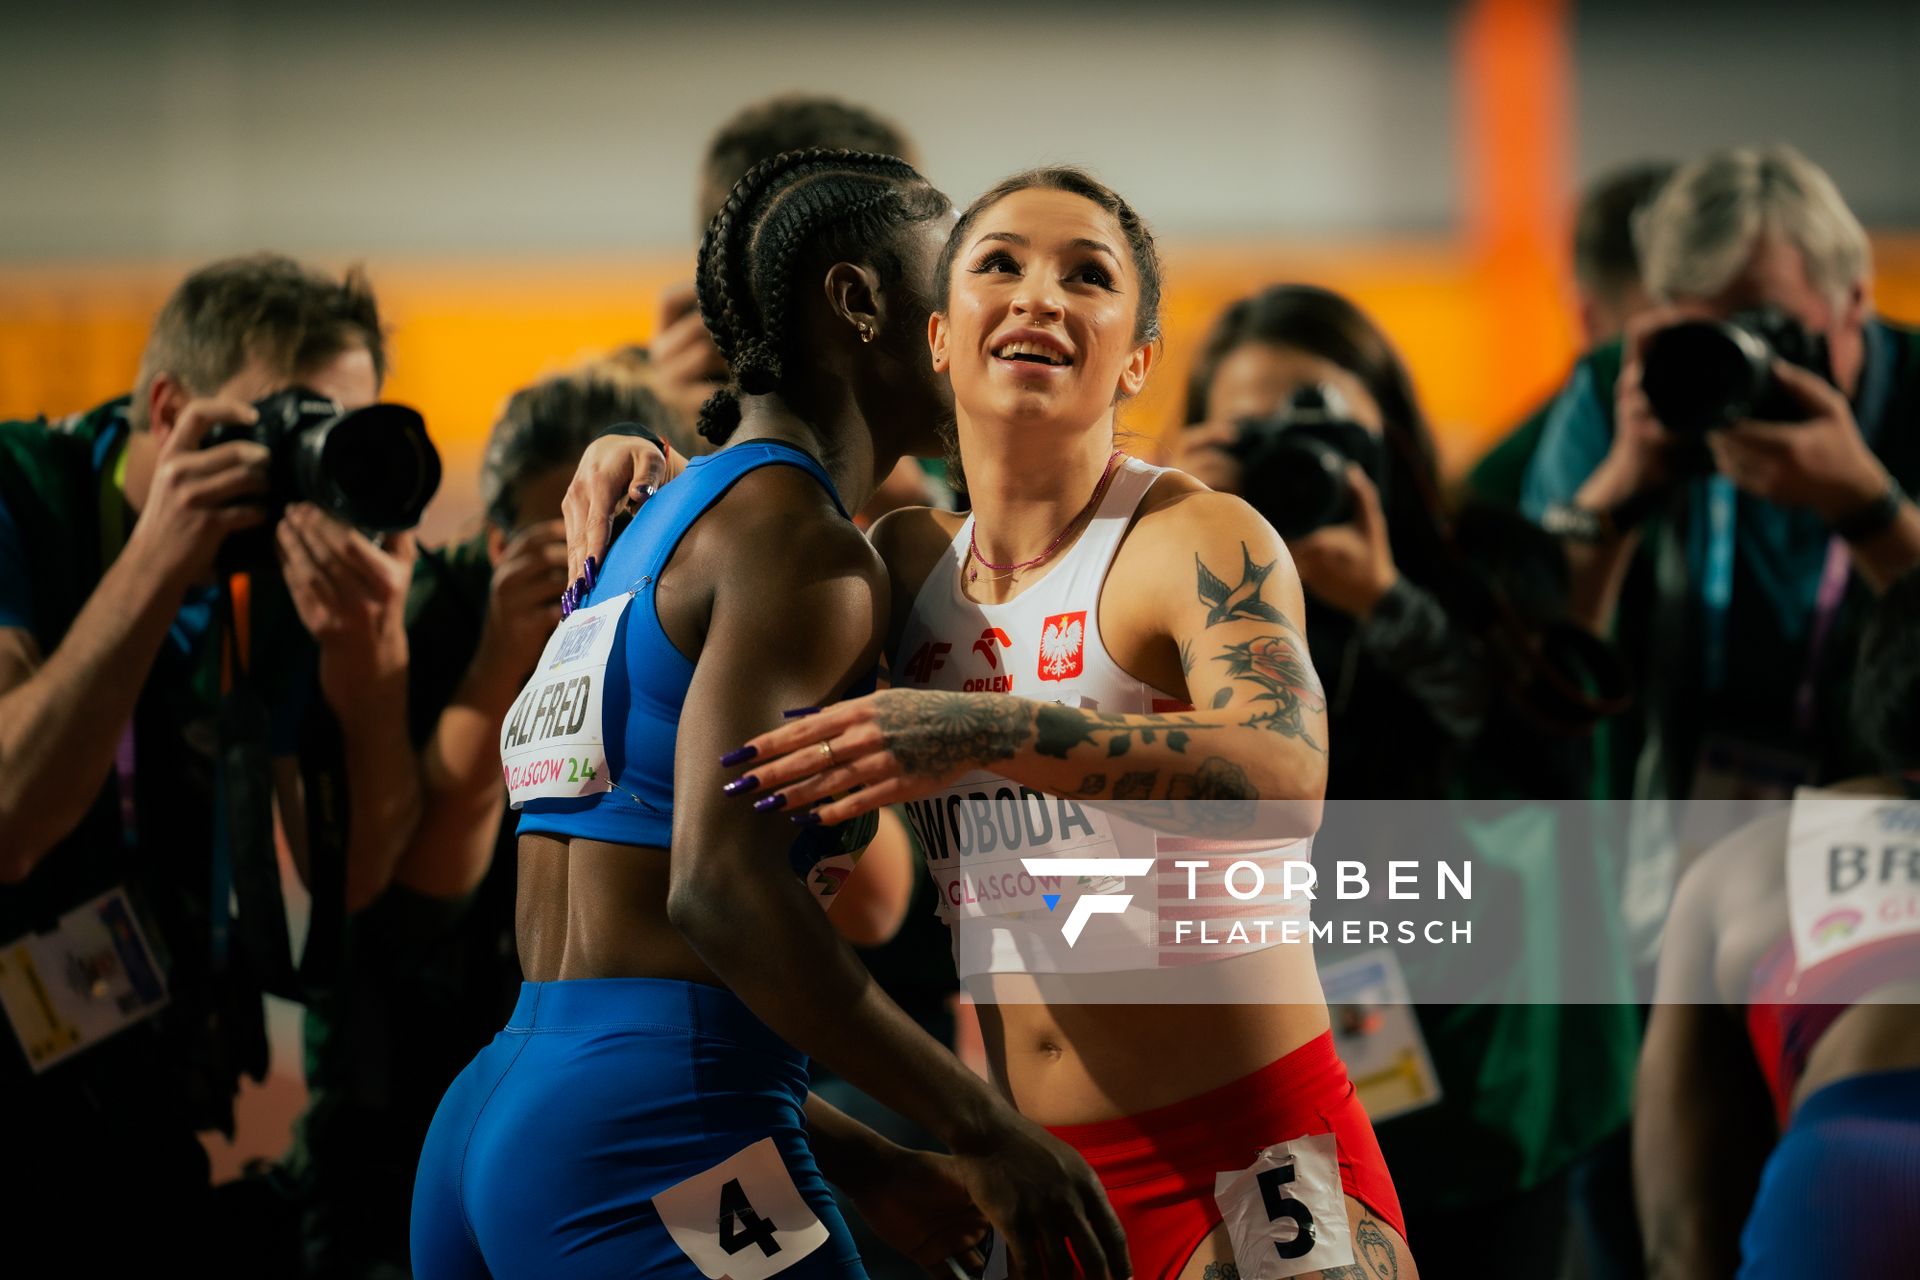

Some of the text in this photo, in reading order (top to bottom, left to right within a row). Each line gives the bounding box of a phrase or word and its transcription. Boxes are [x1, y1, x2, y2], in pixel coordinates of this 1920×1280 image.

[504, 675, 591, 750] ALFRED
[962, 674, 1014, 693] ORLEN
[509, 757, 596, 791] GLASGOW 24
[719, 1177, 783, 1258] 4
[1256, 1164, 1316, 1259] 5
